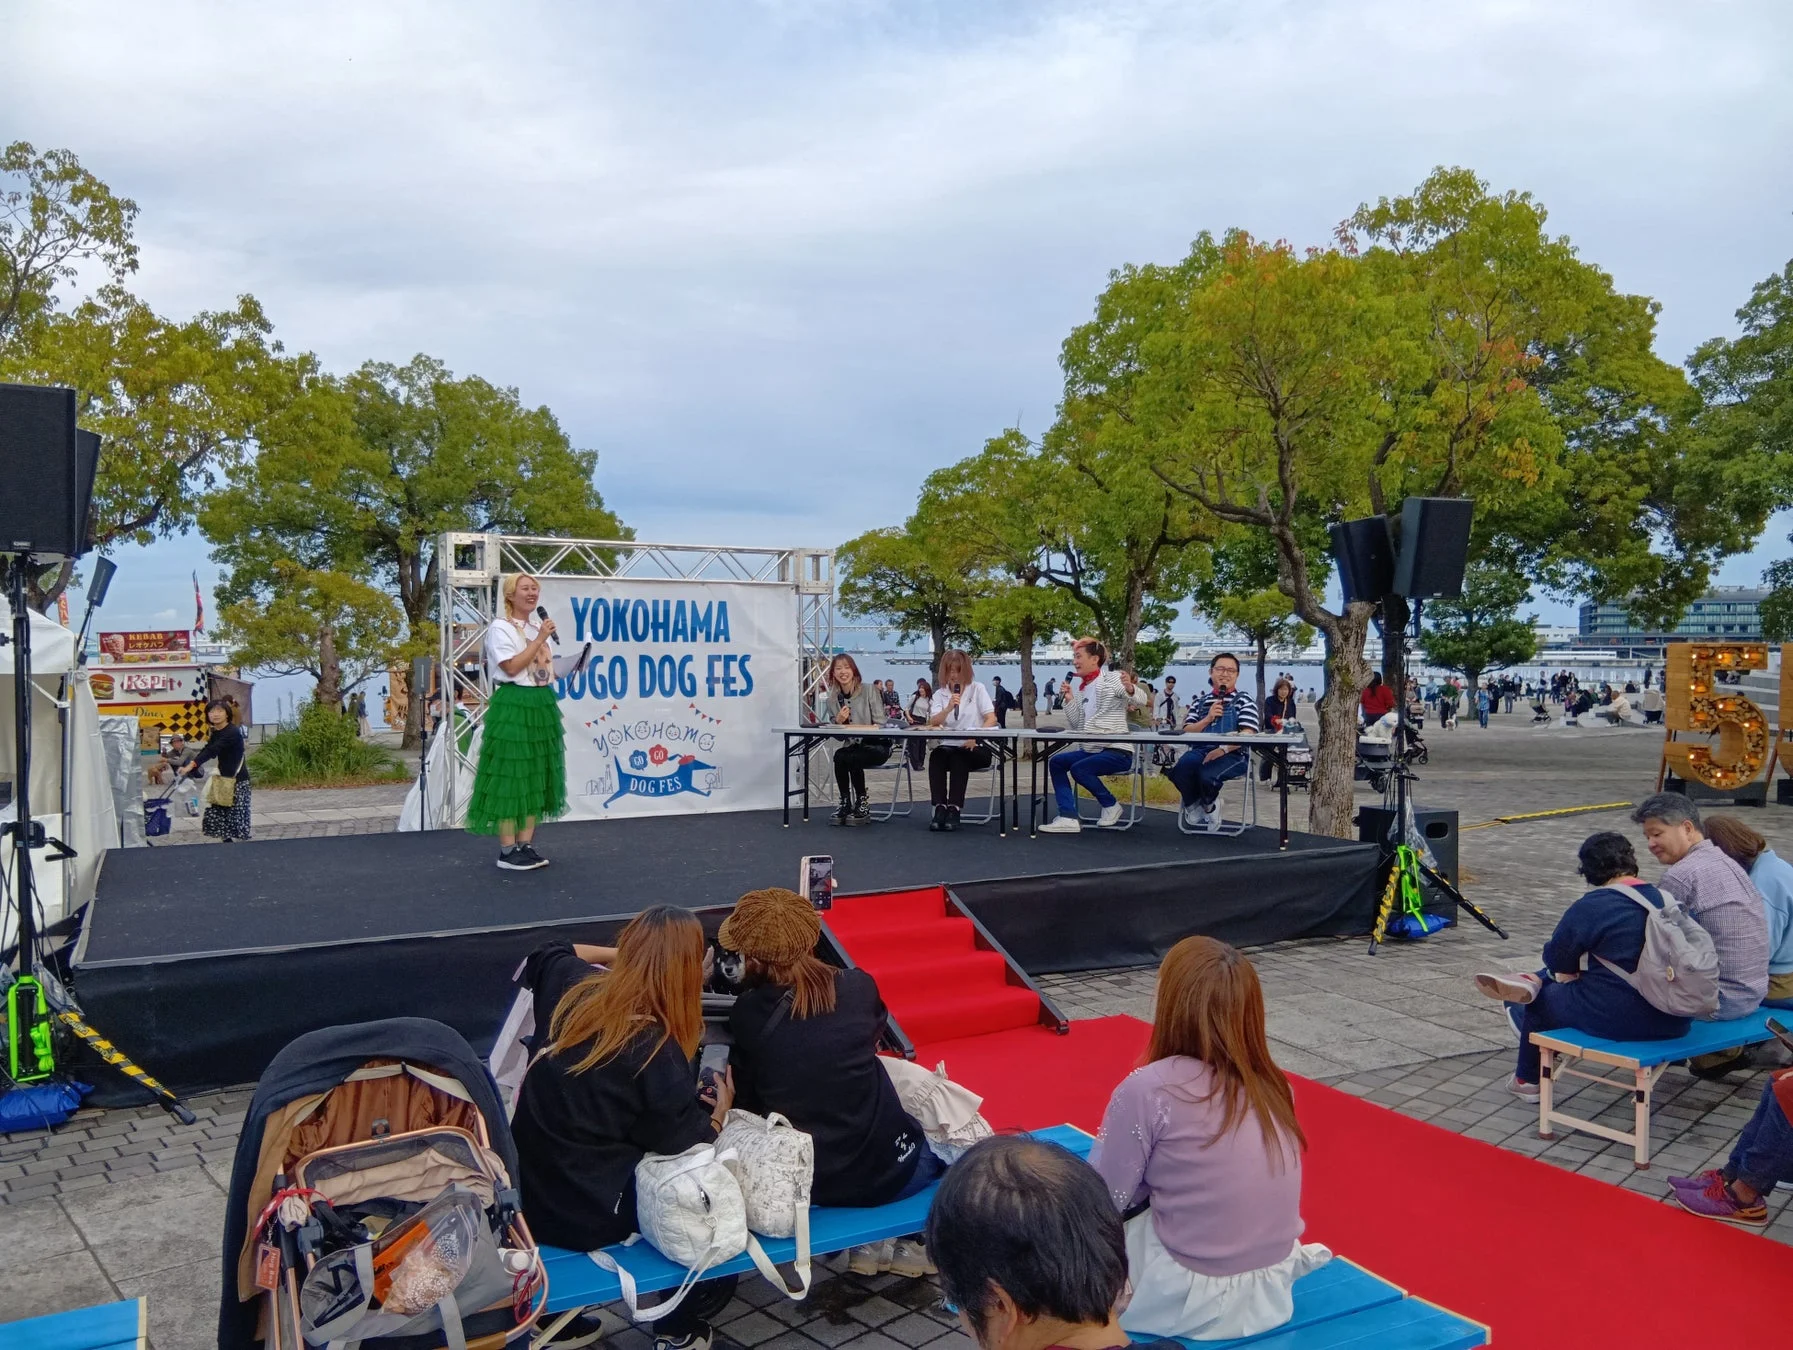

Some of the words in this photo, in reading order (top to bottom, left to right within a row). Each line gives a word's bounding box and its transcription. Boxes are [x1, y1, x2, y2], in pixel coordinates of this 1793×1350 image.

[570, 597, 730, 643] YOKOHAMA
[129, 633, 164, 641] KEBAB
[638, 654, 697, 699] DOG
[706, 654, 754, 698] FES
[634, 756, 644, 766] GO
[654, 750, 664, 760] GO
[630, 778, 655, 794] DOG
[660, 776, 682, 793] FES
